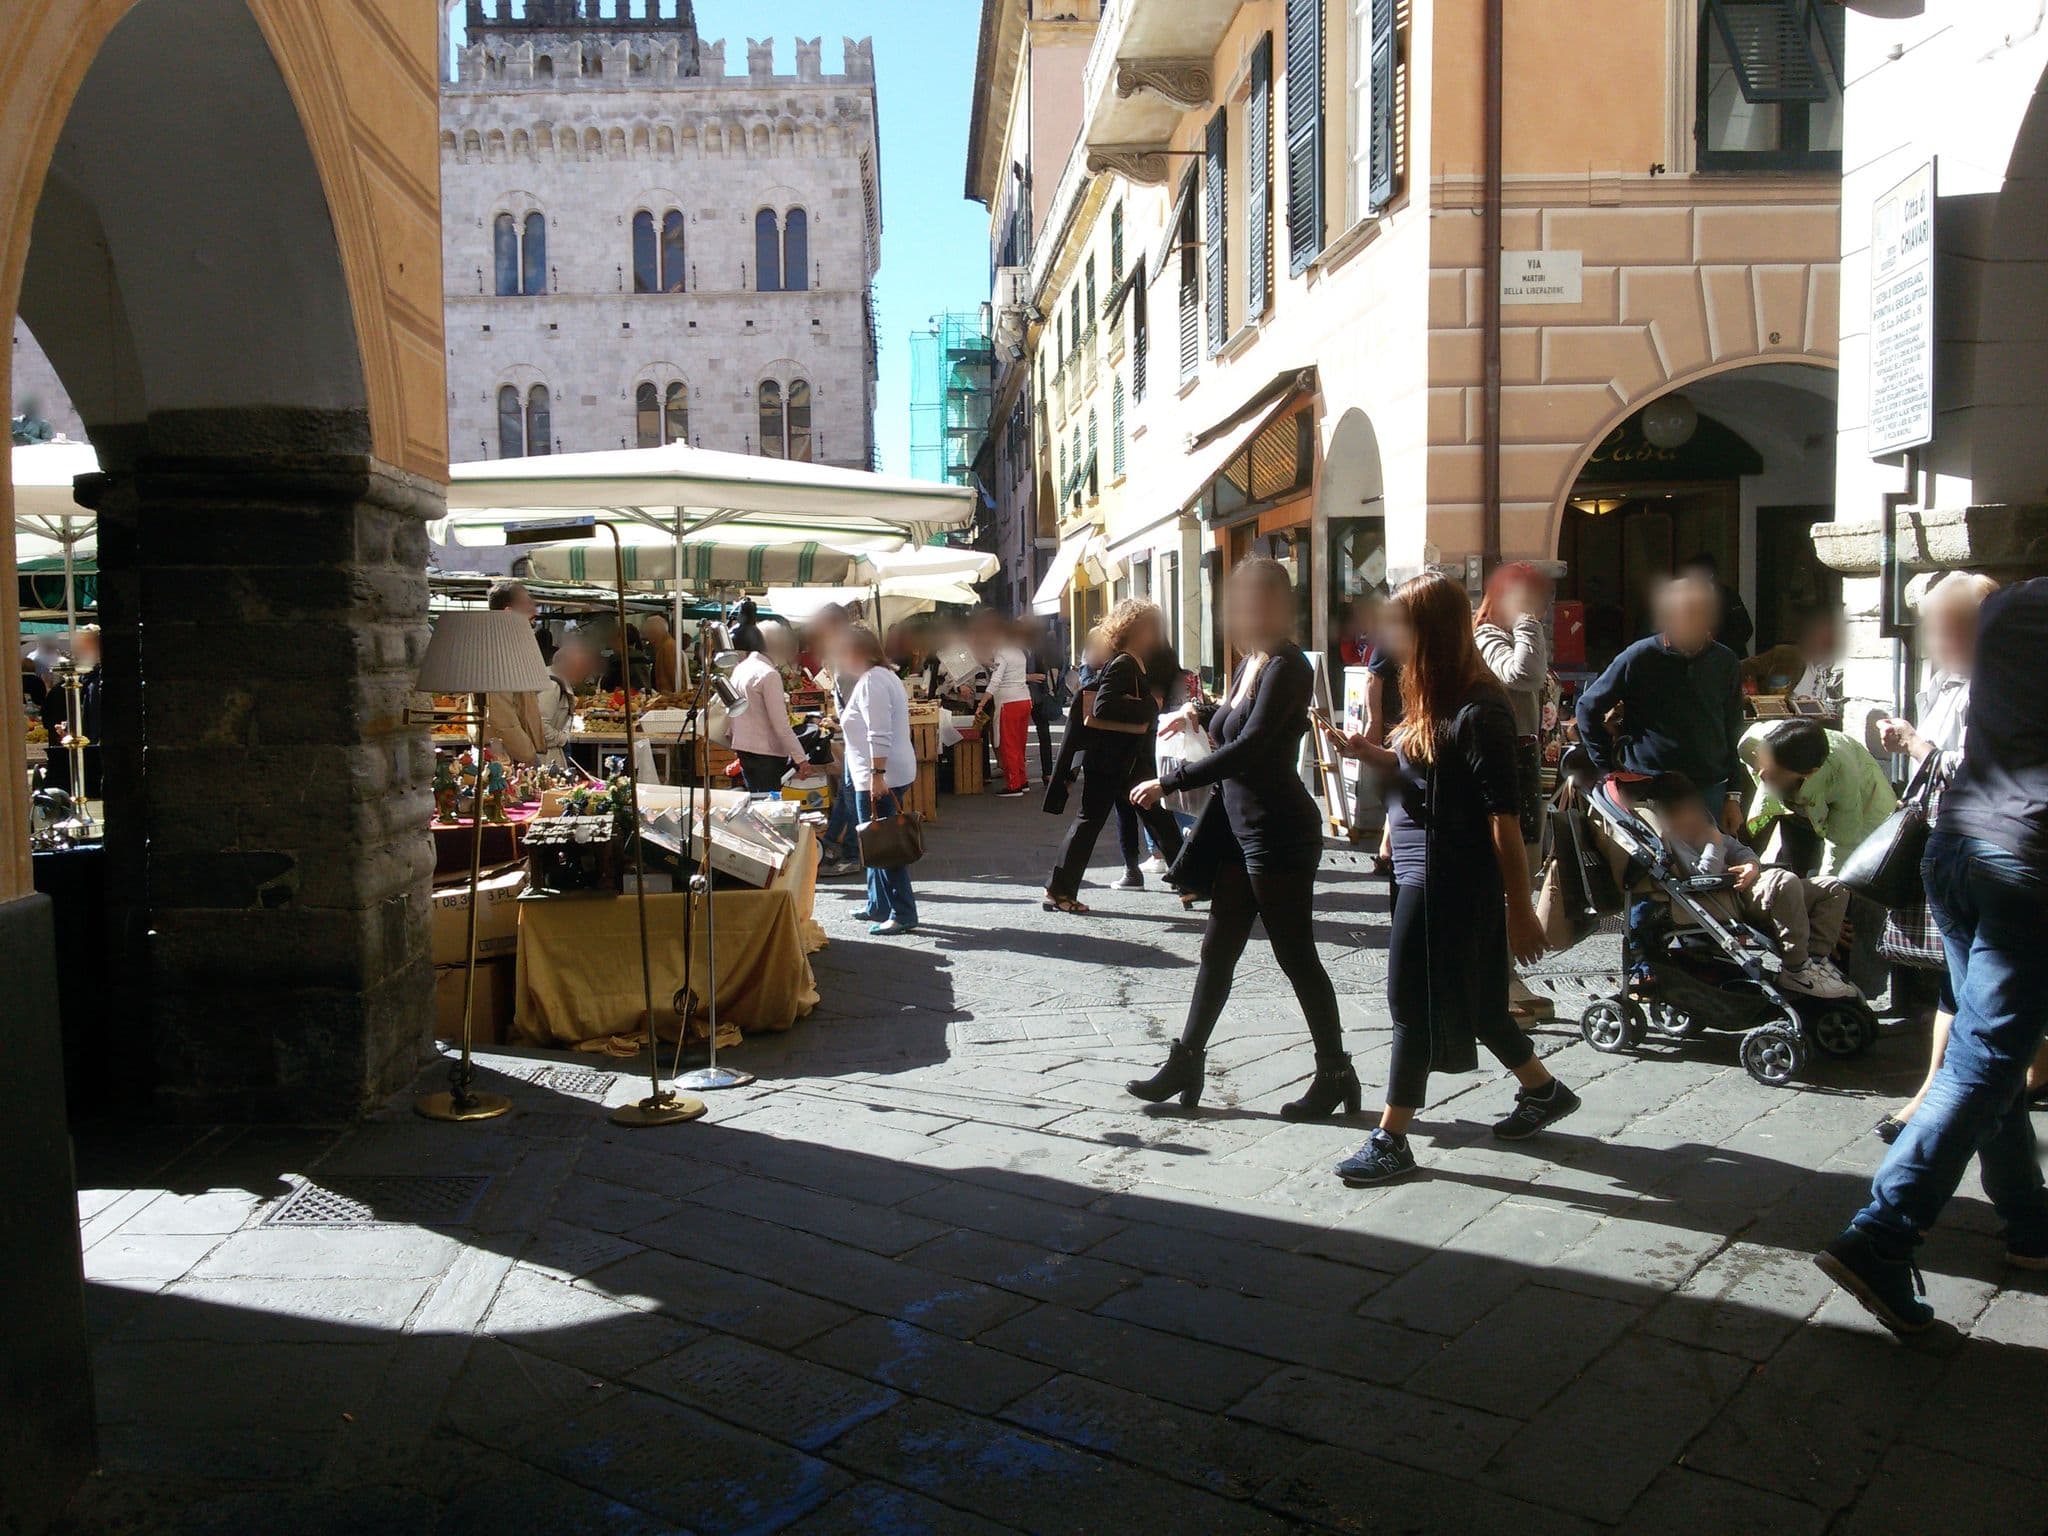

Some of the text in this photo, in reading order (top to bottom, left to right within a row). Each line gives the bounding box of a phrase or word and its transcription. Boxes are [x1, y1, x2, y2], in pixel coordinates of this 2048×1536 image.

[1901, 218, 1929, 256] CHIAVARI
[1527, 259, 1542, 269] VIA
[1503, 286, 1565, 295] DELLA LIBERAZIONE
